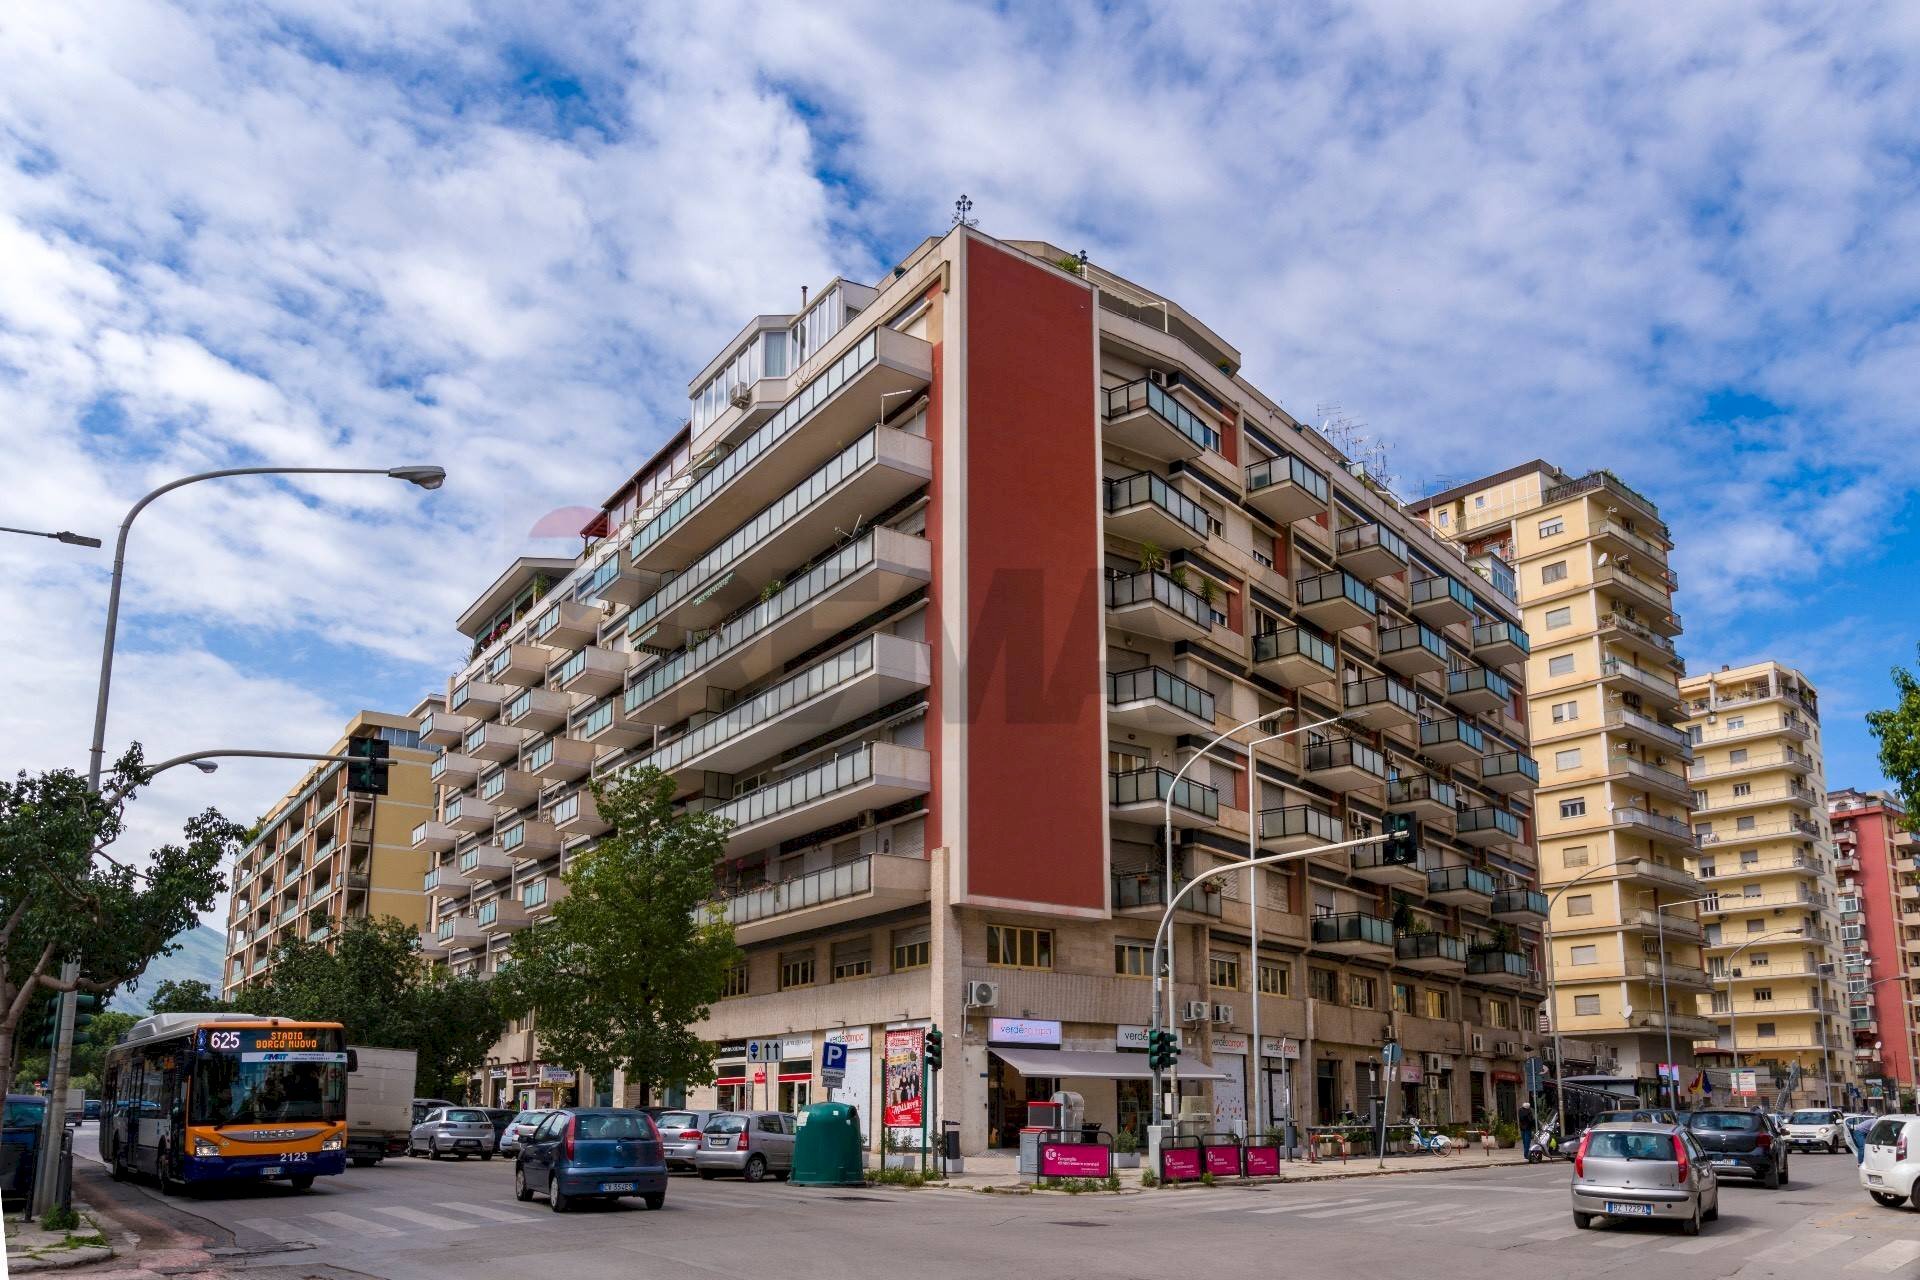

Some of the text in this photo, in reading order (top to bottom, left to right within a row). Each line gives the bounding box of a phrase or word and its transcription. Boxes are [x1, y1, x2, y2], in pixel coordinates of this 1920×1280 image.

[211, 1031, 240, 1049] 625
[271, 1032, 304, 1040] STADIO
[256, 1040, 317, 1049] BORGO NUOVO
[263, 1053, 289, 1061] AMAT
[827, 1045, 843, 1066] P
[280, 1152, 308, 1162] 2123
